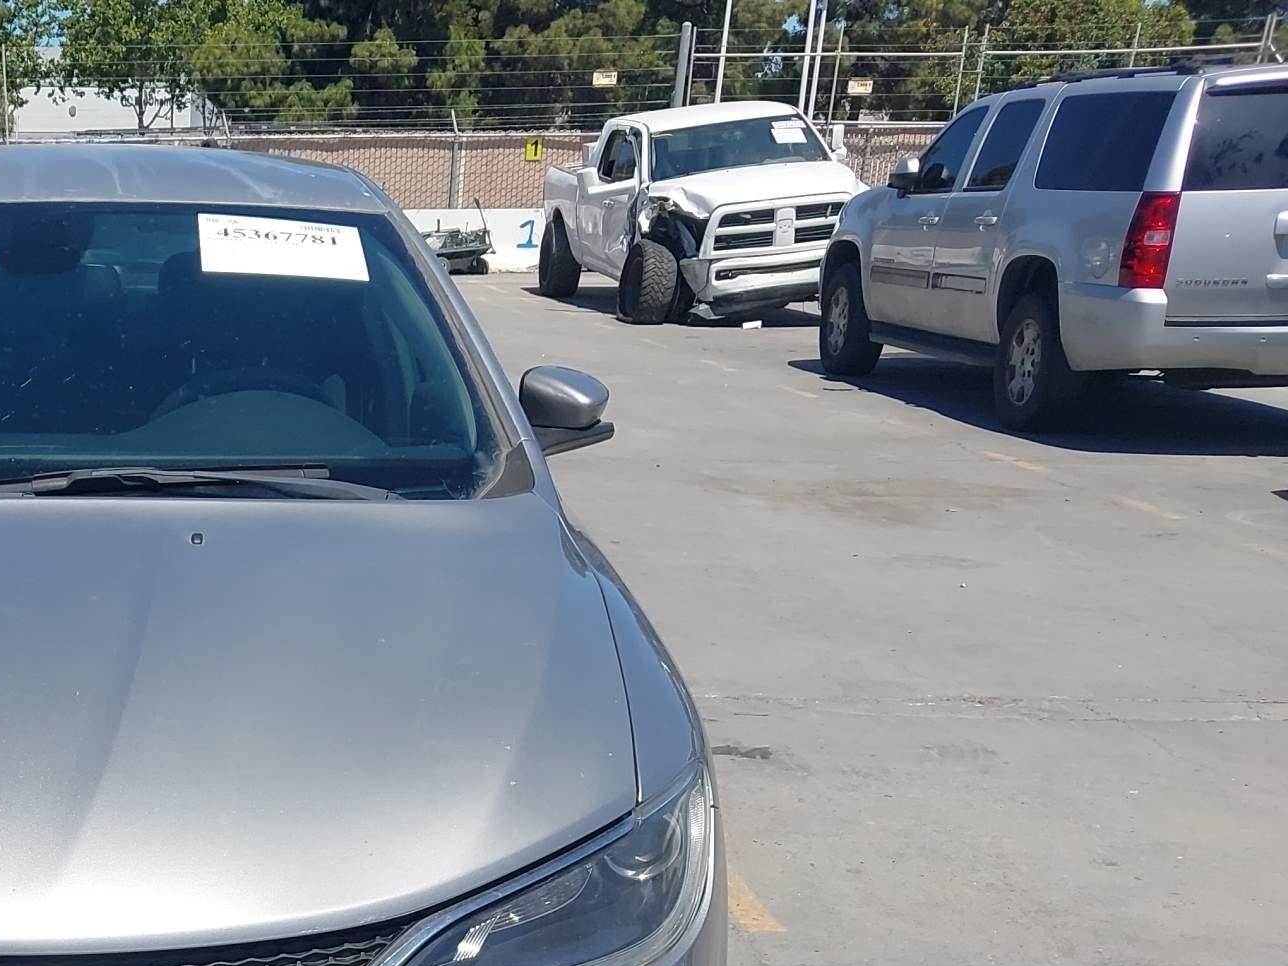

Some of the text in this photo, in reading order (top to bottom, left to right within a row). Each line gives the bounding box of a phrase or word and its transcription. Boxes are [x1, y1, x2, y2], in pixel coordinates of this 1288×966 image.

[530, 139, 539, 157] 1
[216, 227, 338, 246] 45367781
[516, 219, 539, 248] 1
